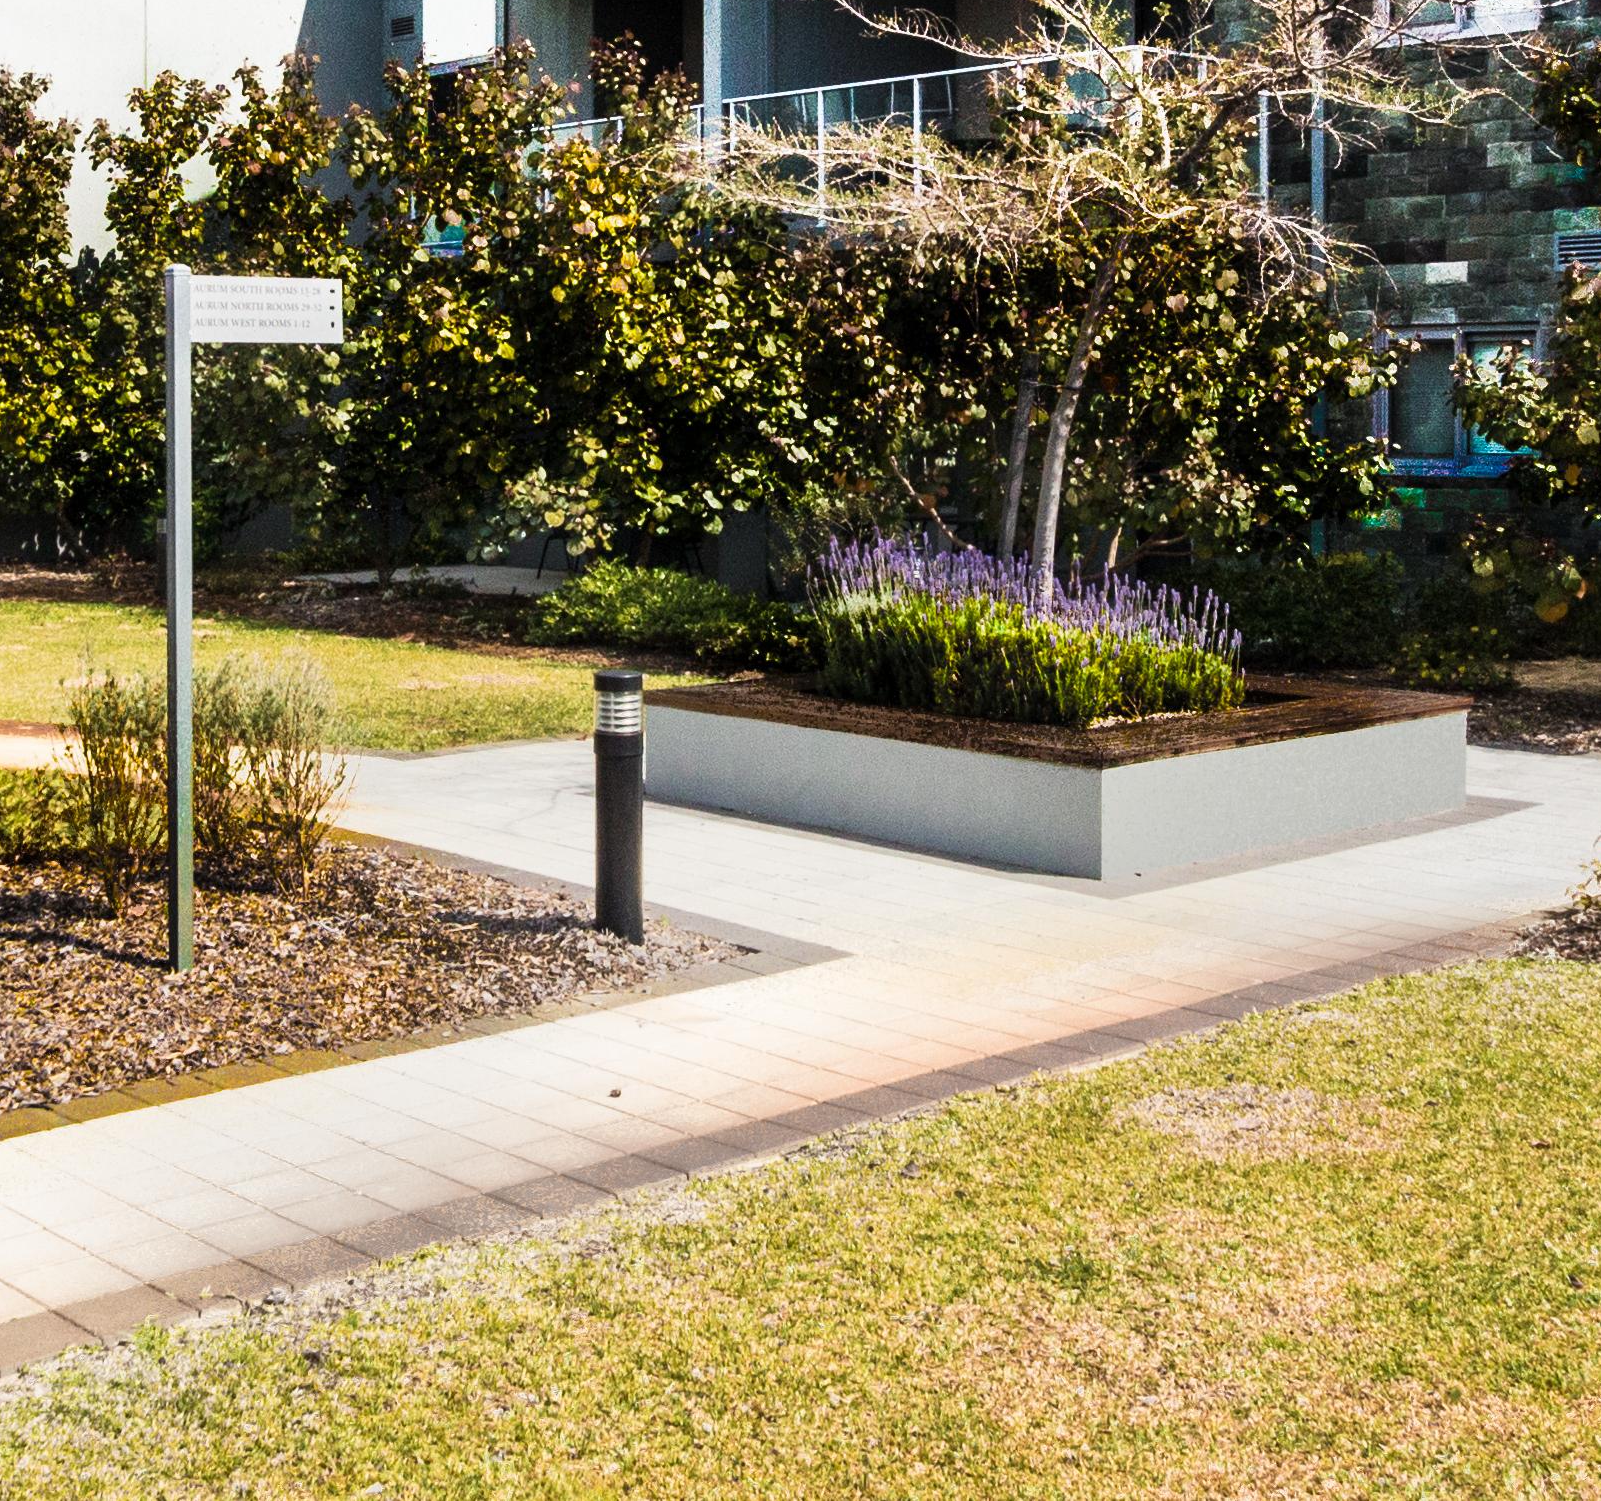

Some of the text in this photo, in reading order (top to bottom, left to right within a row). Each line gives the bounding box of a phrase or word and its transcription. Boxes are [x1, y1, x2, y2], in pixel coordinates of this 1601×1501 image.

[195, 284, 227, 294] AURUM
[229, 285, 261, 295] SOUTH
[264, 286, 298, 296] ROOMS
[195, 301, 228, 311] AURUM
[231, 302, 264, 312] NORTH
[266, 302, 299, 312] ROOMS
[195, 318, 229, 328] AURUM
[231, 318, 257, 328] WEST
[259, 318, 292, 328] ROOMS
